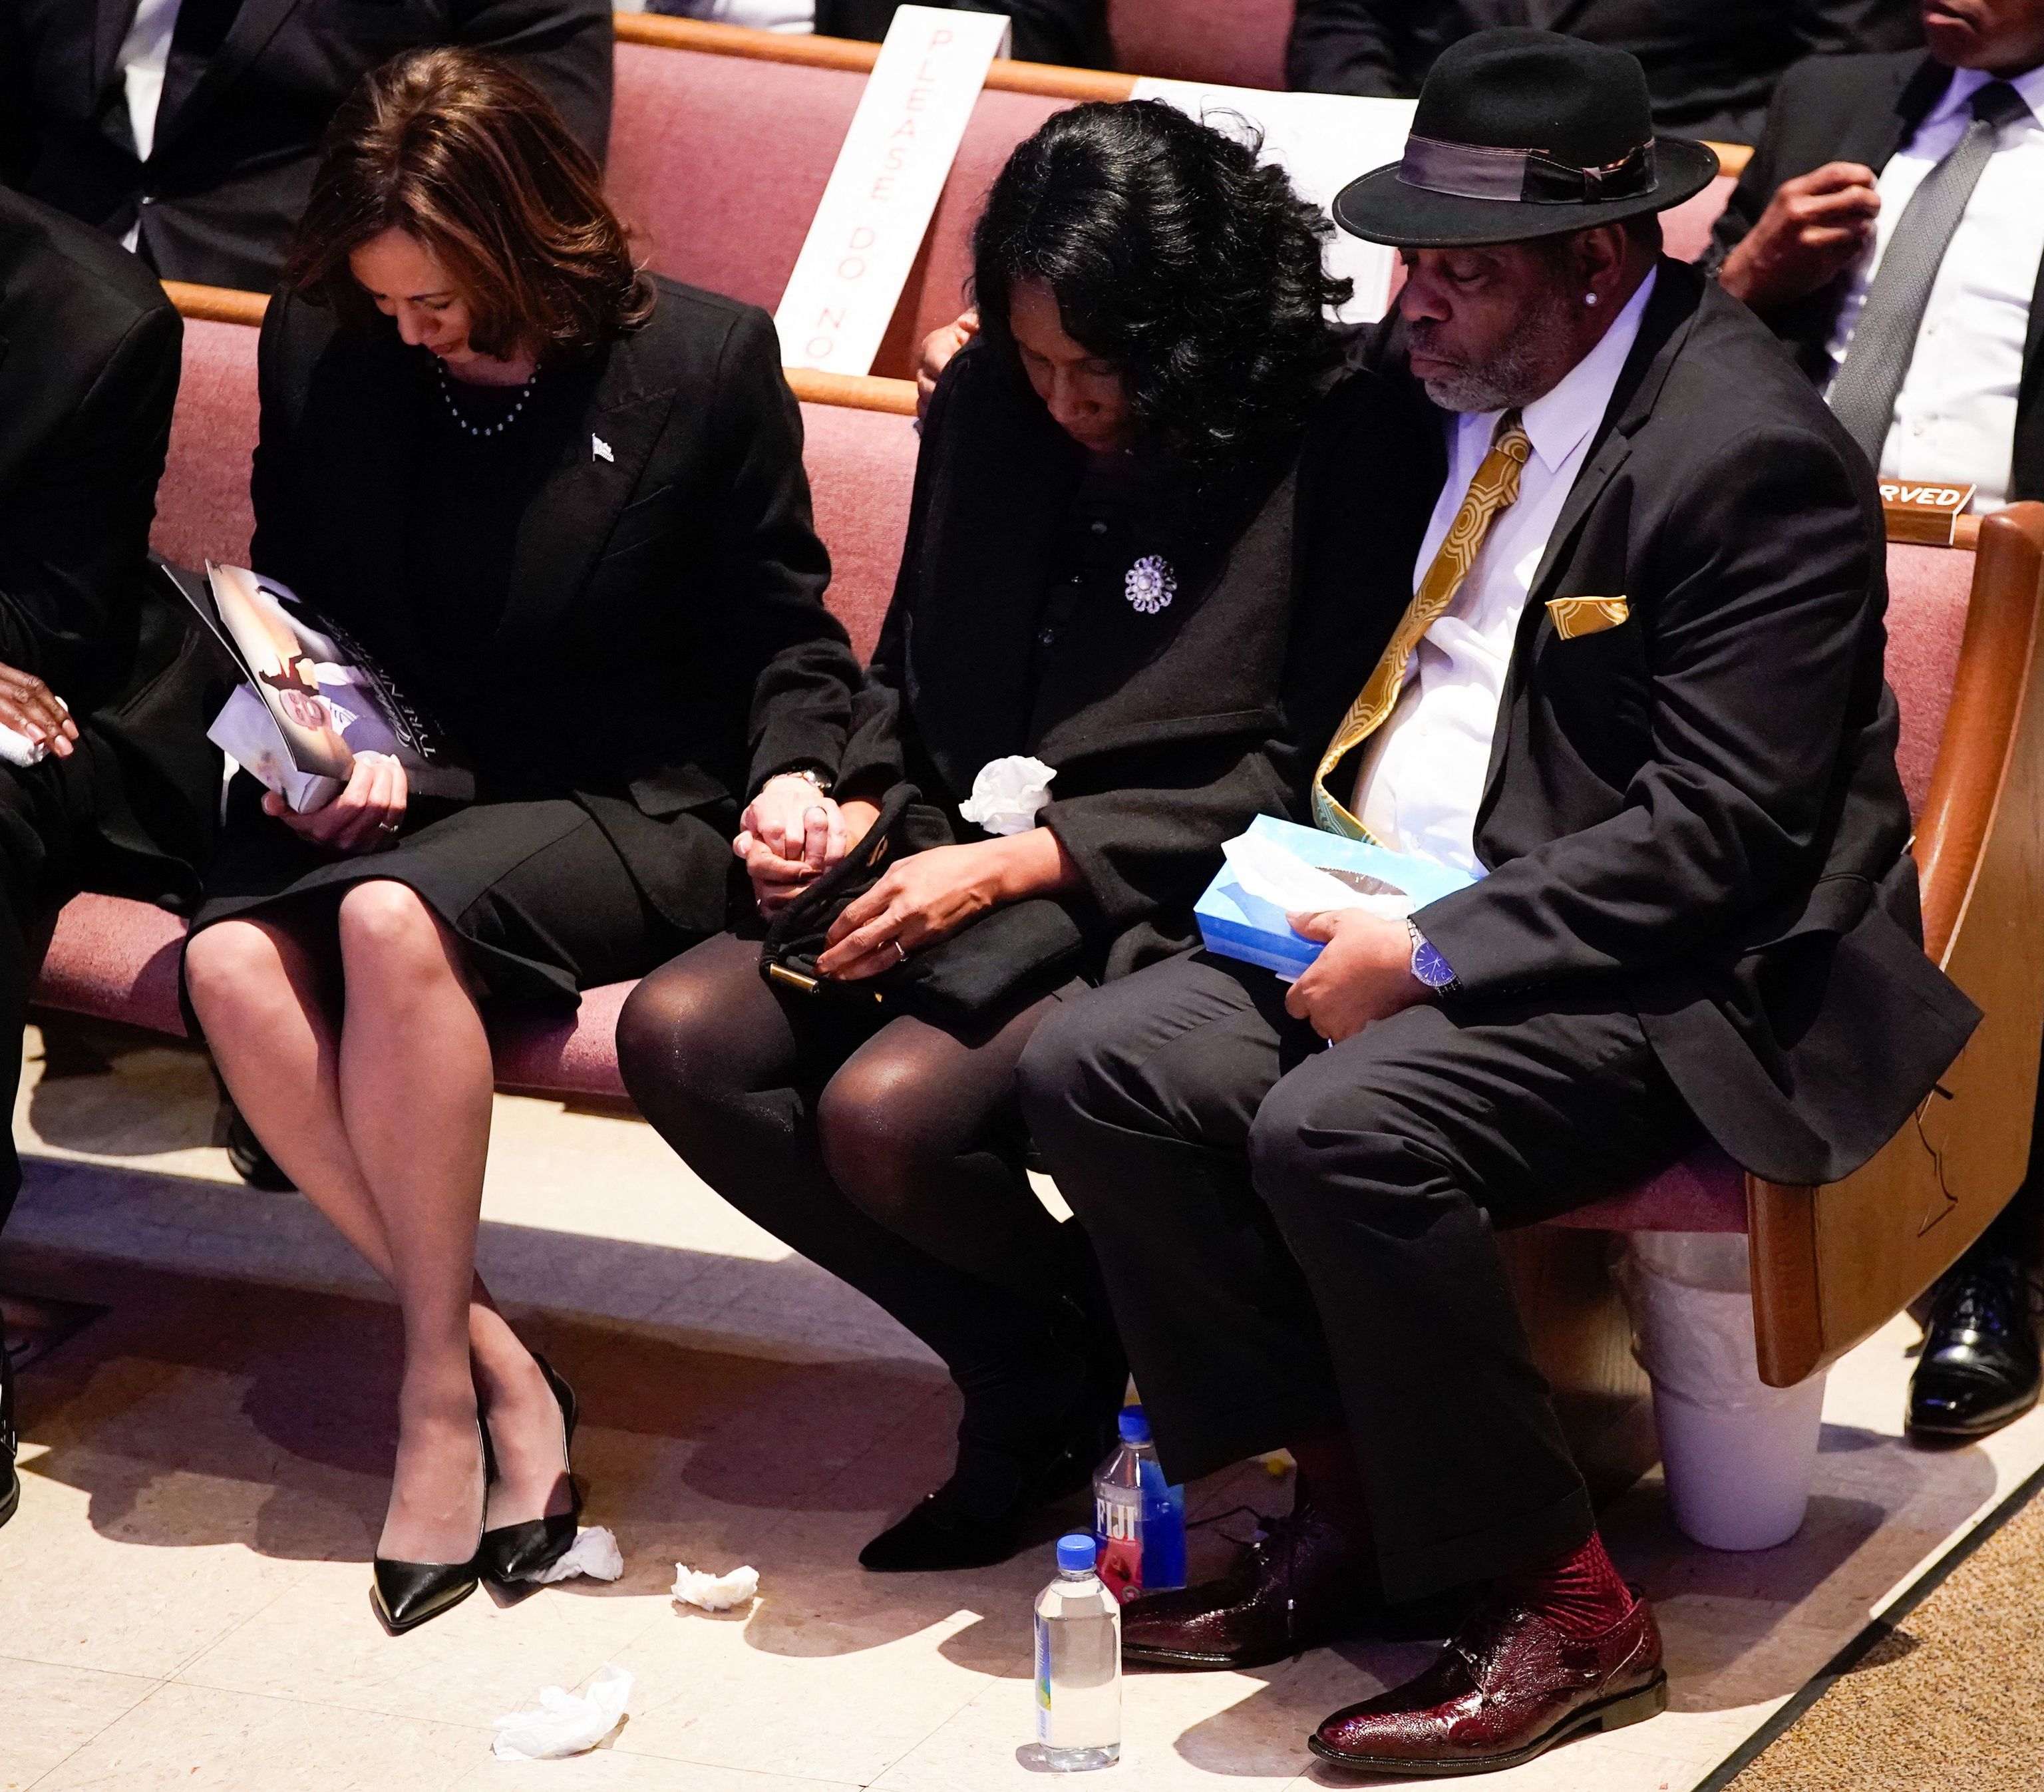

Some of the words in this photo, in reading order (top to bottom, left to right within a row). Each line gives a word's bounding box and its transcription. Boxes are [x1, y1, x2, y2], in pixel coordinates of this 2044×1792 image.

[870, 29, 953, 201] PLEASE
[838, 227, 876, 279] DO
[801, 307, 846, 371] NO
[1878, 484, 1961, 506] RVED
[1097, 1497, 1136, 1542] FIJI
